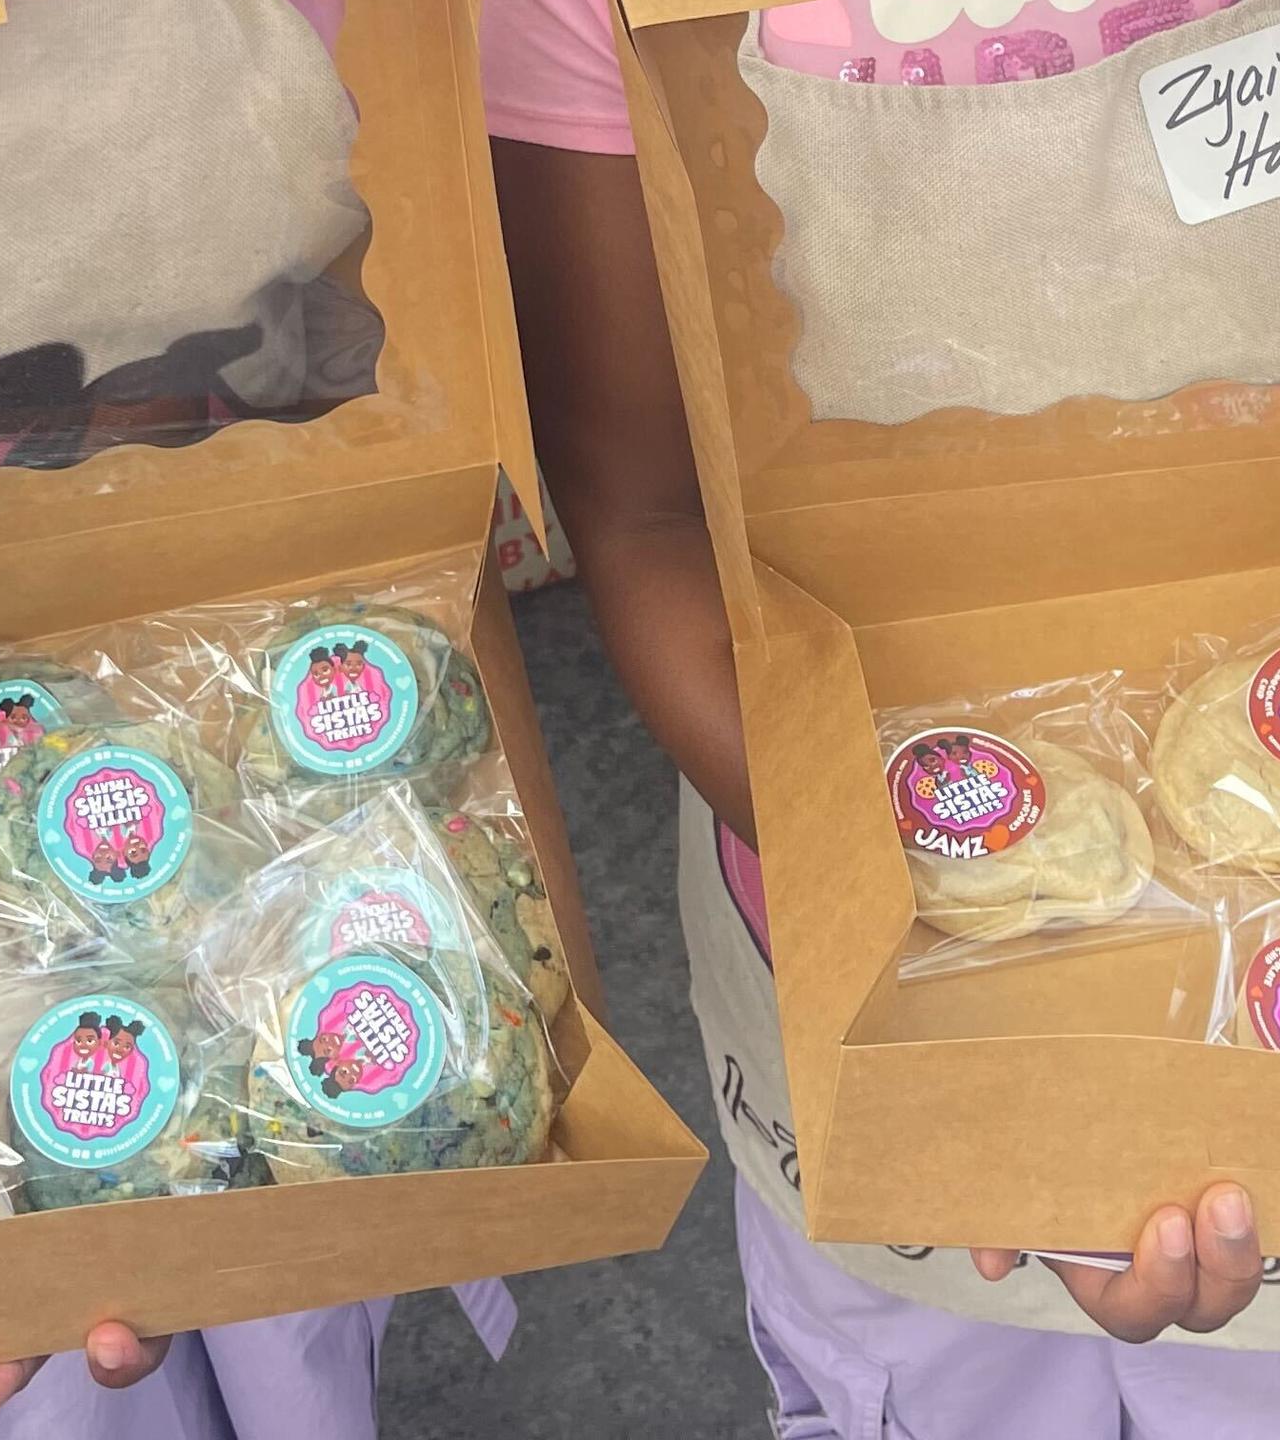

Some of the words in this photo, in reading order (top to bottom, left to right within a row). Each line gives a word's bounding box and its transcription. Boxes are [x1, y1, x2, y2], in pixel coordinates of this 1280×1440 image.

[317, 692, 370, 714] LITTLE
[310, 704, 382, 734] SISTAS
[326, 723, 373, 742] TREATS
[75, 787, 149, 816] SISTAS
[84, 778, 133, 796] TREATS
[932, 782, 1009, 820] SISTAS
[934, 774, 991, 801] LITTLE
[87, 806, 142, 828] LITTLE
[953, 800, 1003, 825] TREATS
[1009, 788, 1032, 831] CHOCOLATE
[914, 828, 989, 859] JAMZ
[352, 989, 409, 1063] SISTAS
[377, 992, 411, 1042] TREATS
[347, 1007, 390, 1066] LITTLE
[65, 1071, 125, 1095] LITTLE
[51, 1086, 132, 1116] SISTAS
[63, 1108, 115, 1128] TREATS
